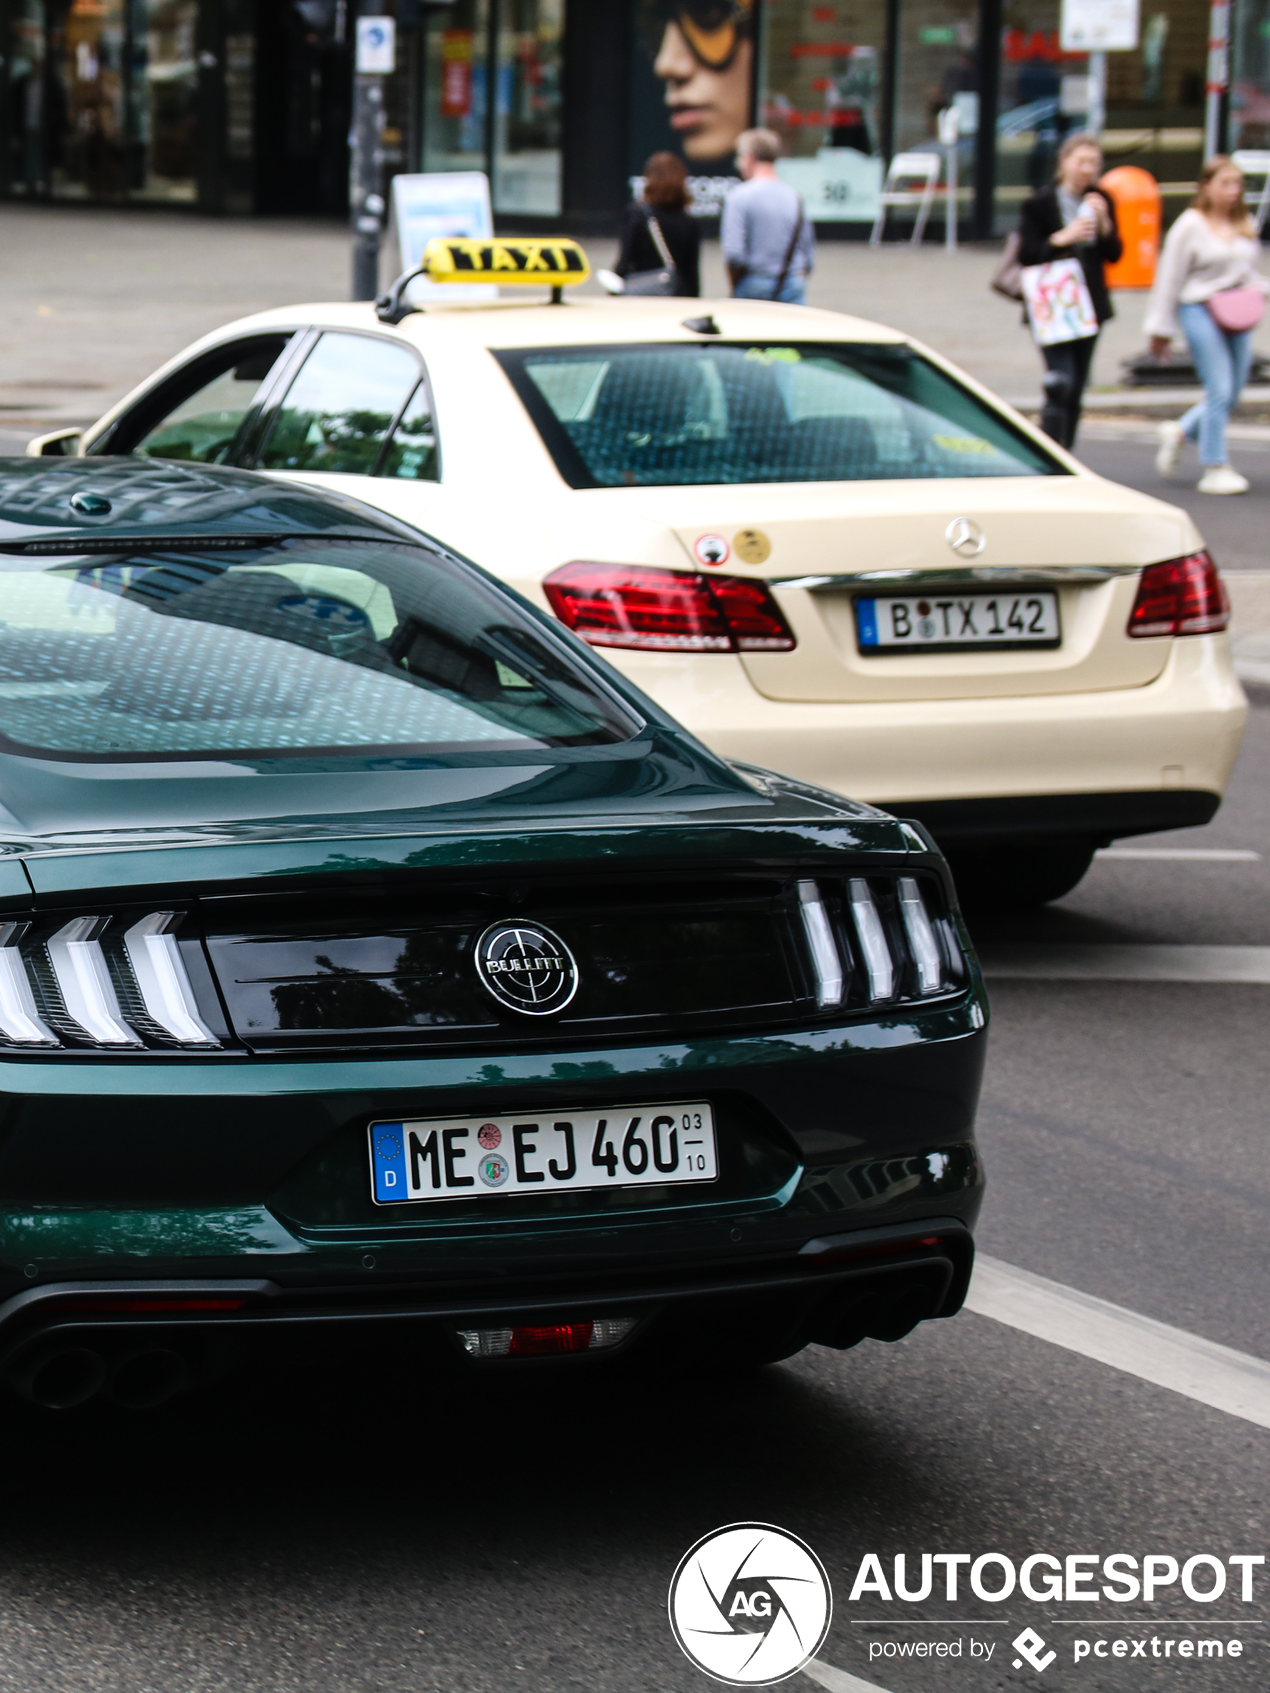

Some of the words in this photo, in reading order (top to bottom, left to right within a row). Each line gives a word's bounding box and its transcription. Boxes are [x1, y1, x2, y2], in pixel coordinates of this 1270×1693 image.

[458, 246, 570, 271] TAXI
[891, 602, 912, 637] B
[935, 600, 978, 637] TX
[986, 598, 1046, 636] 142
[681, 1113, 703, 1131] 03
[408, 1127, 475, 1190] ME
[512, 1121, 577, 1183] EJ
[592, 1115, 680, 1178] 460
[685, 1153, 706, 1172] 10
[384, 1170, 397, 1188] D
